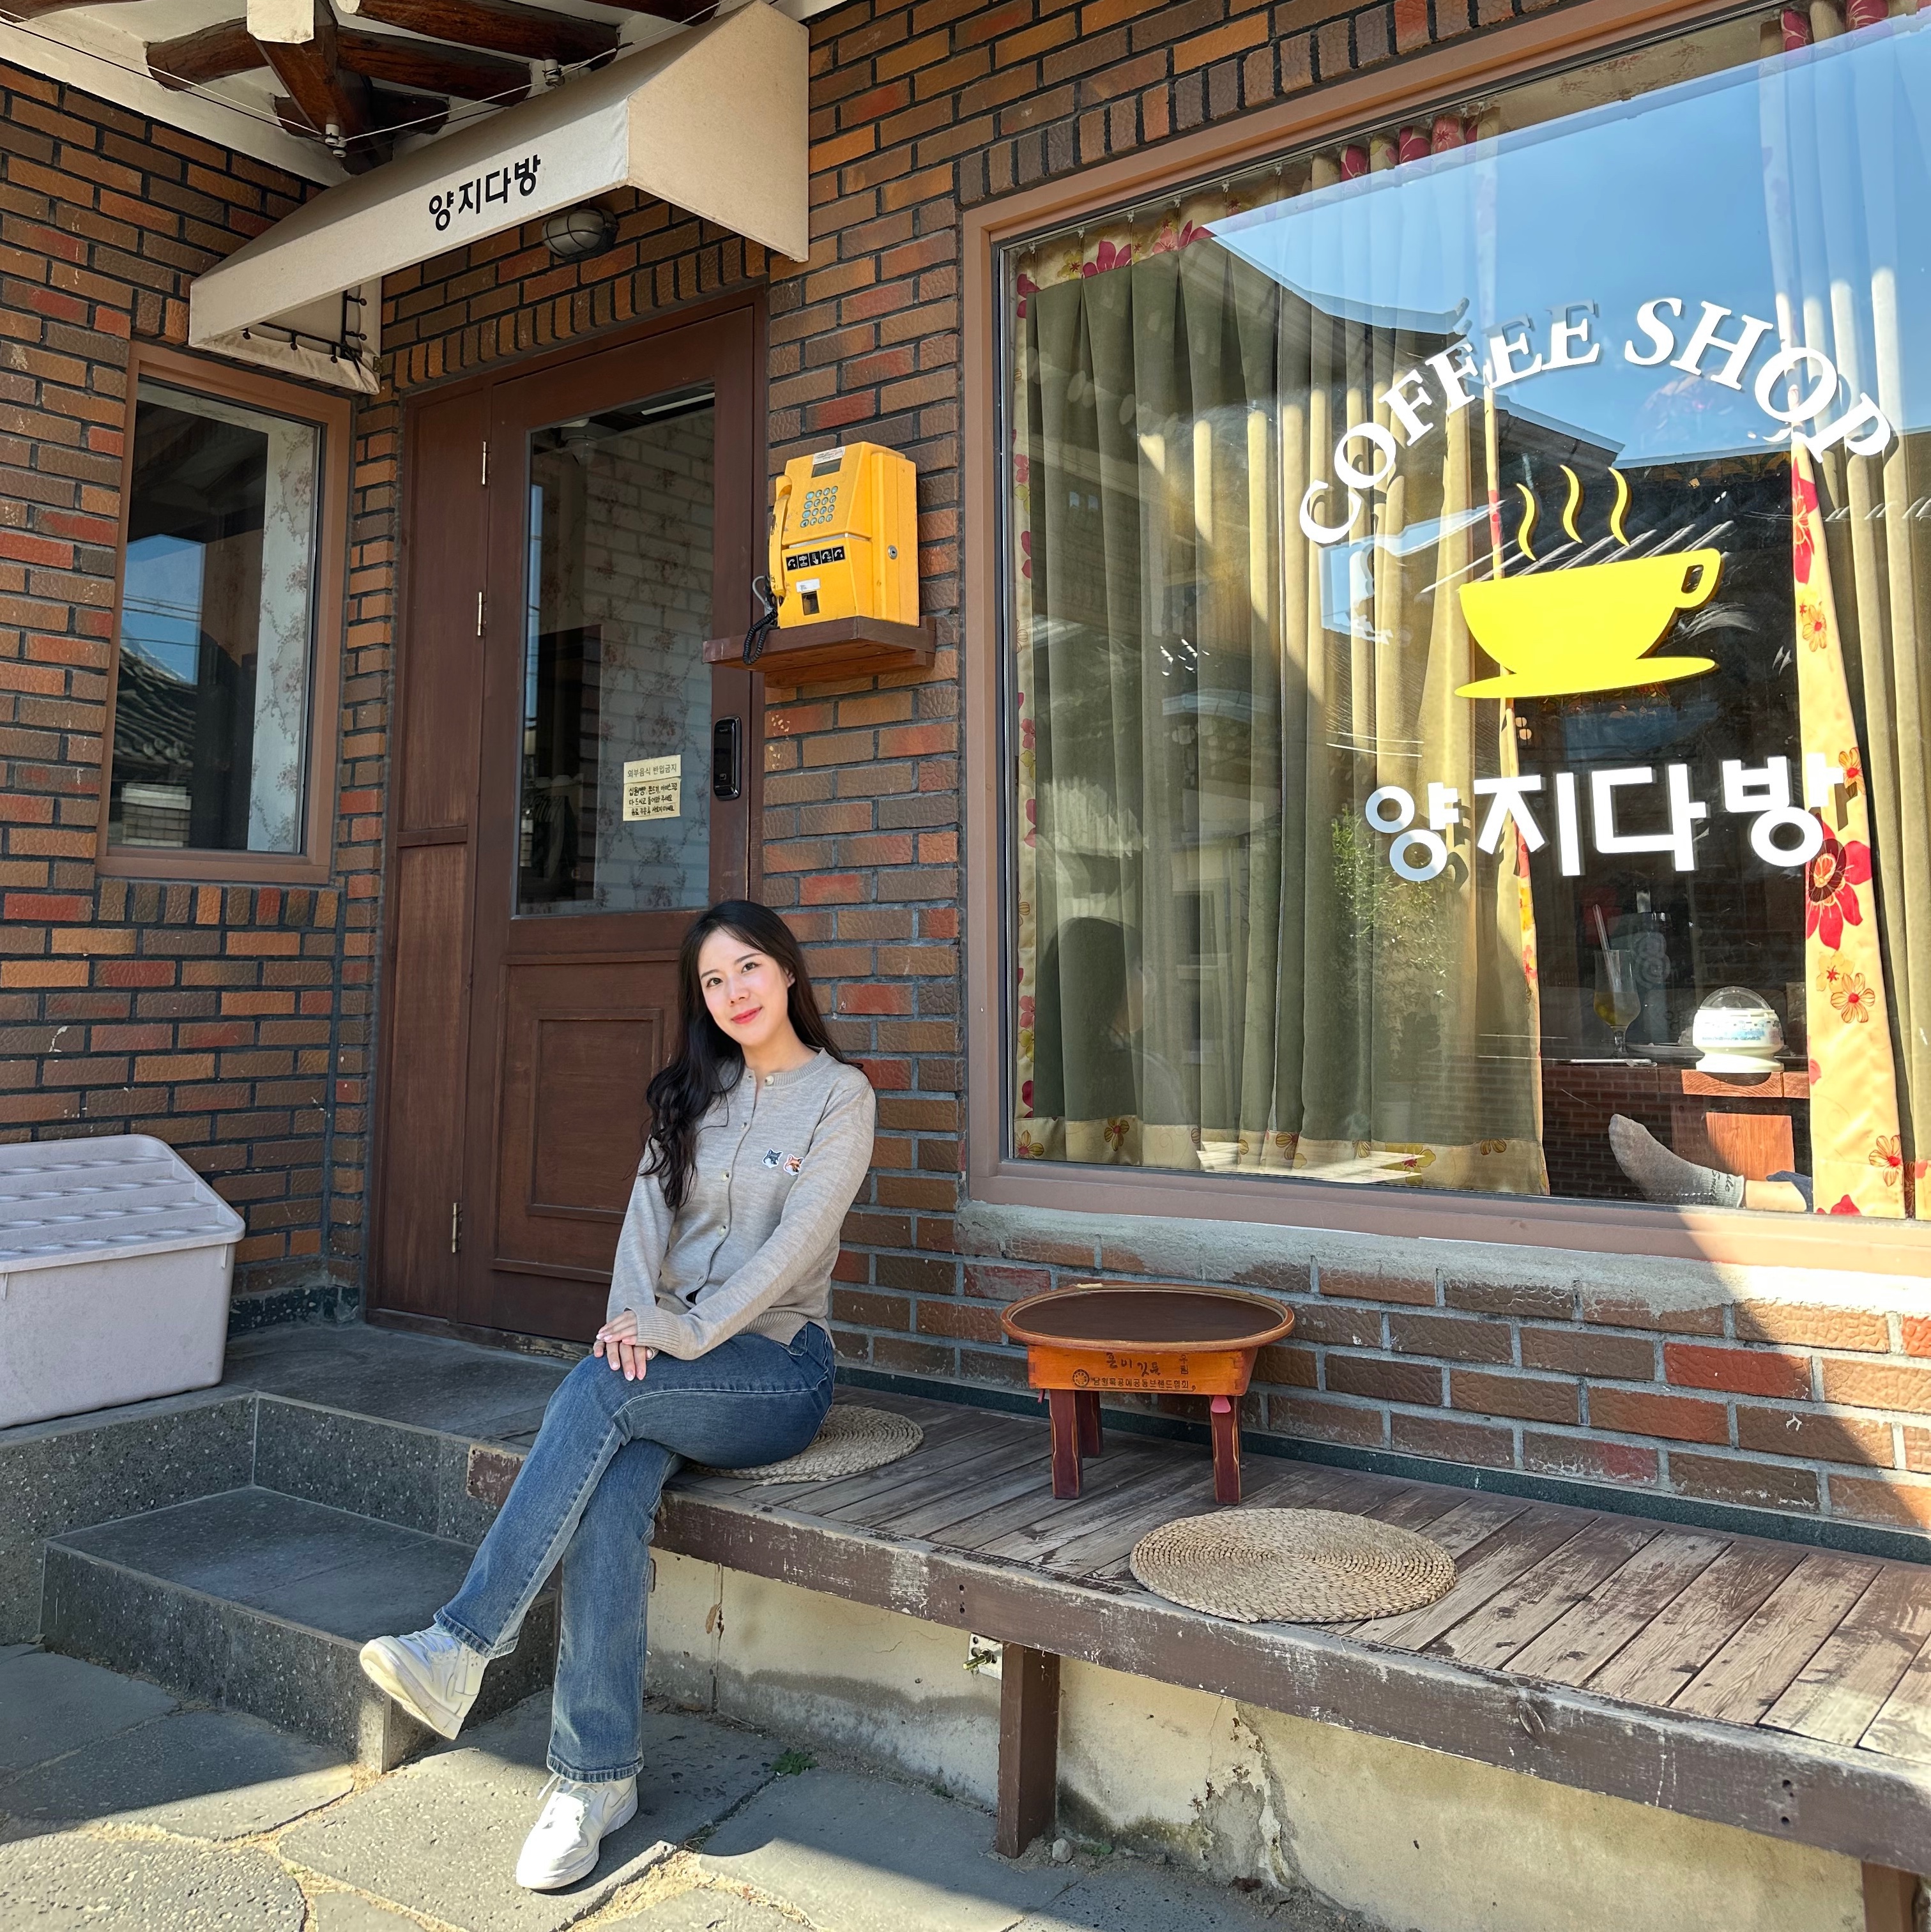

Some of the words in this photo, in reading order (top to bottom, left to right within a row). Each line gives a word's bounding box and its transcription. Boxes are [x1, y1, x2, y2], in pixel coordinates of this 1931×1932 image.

[429, 154, 541, 231] 양지다방
[1299, 299, 1601, 545] COFFEE
[1624, 296, 1892, 464] SHOP
[627, 767, 651, 778] 외부음식
[653, 763, 677, 775] 반입금지
[1366, 752, 1845, 883] 양지다방
